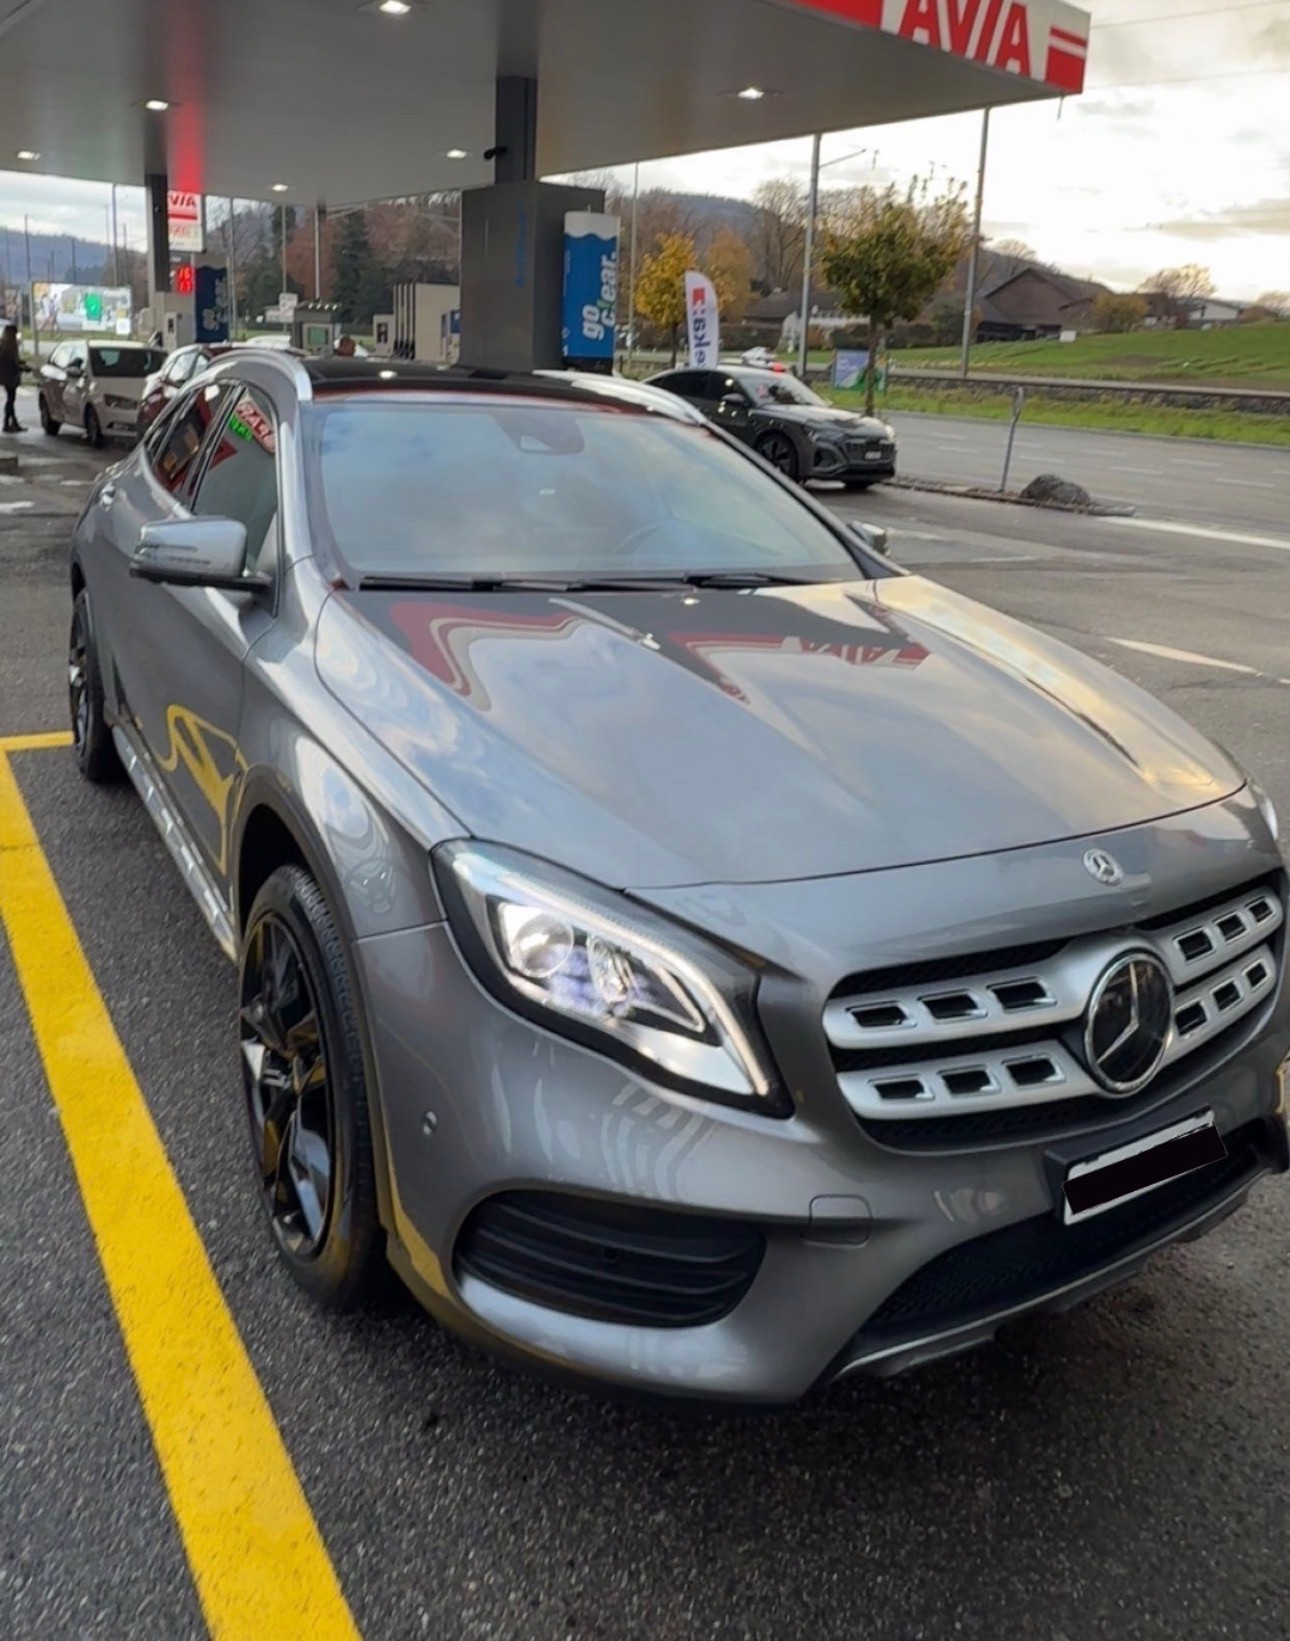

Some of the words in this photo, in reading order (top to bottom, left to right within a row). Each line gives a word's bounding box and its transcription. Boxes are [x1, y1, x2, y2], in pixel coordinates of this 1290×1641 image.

[898, 0, 1032, 78] AVIA
[169, 194, 196, 208] VIA
[581, 303, 605, 341] go
